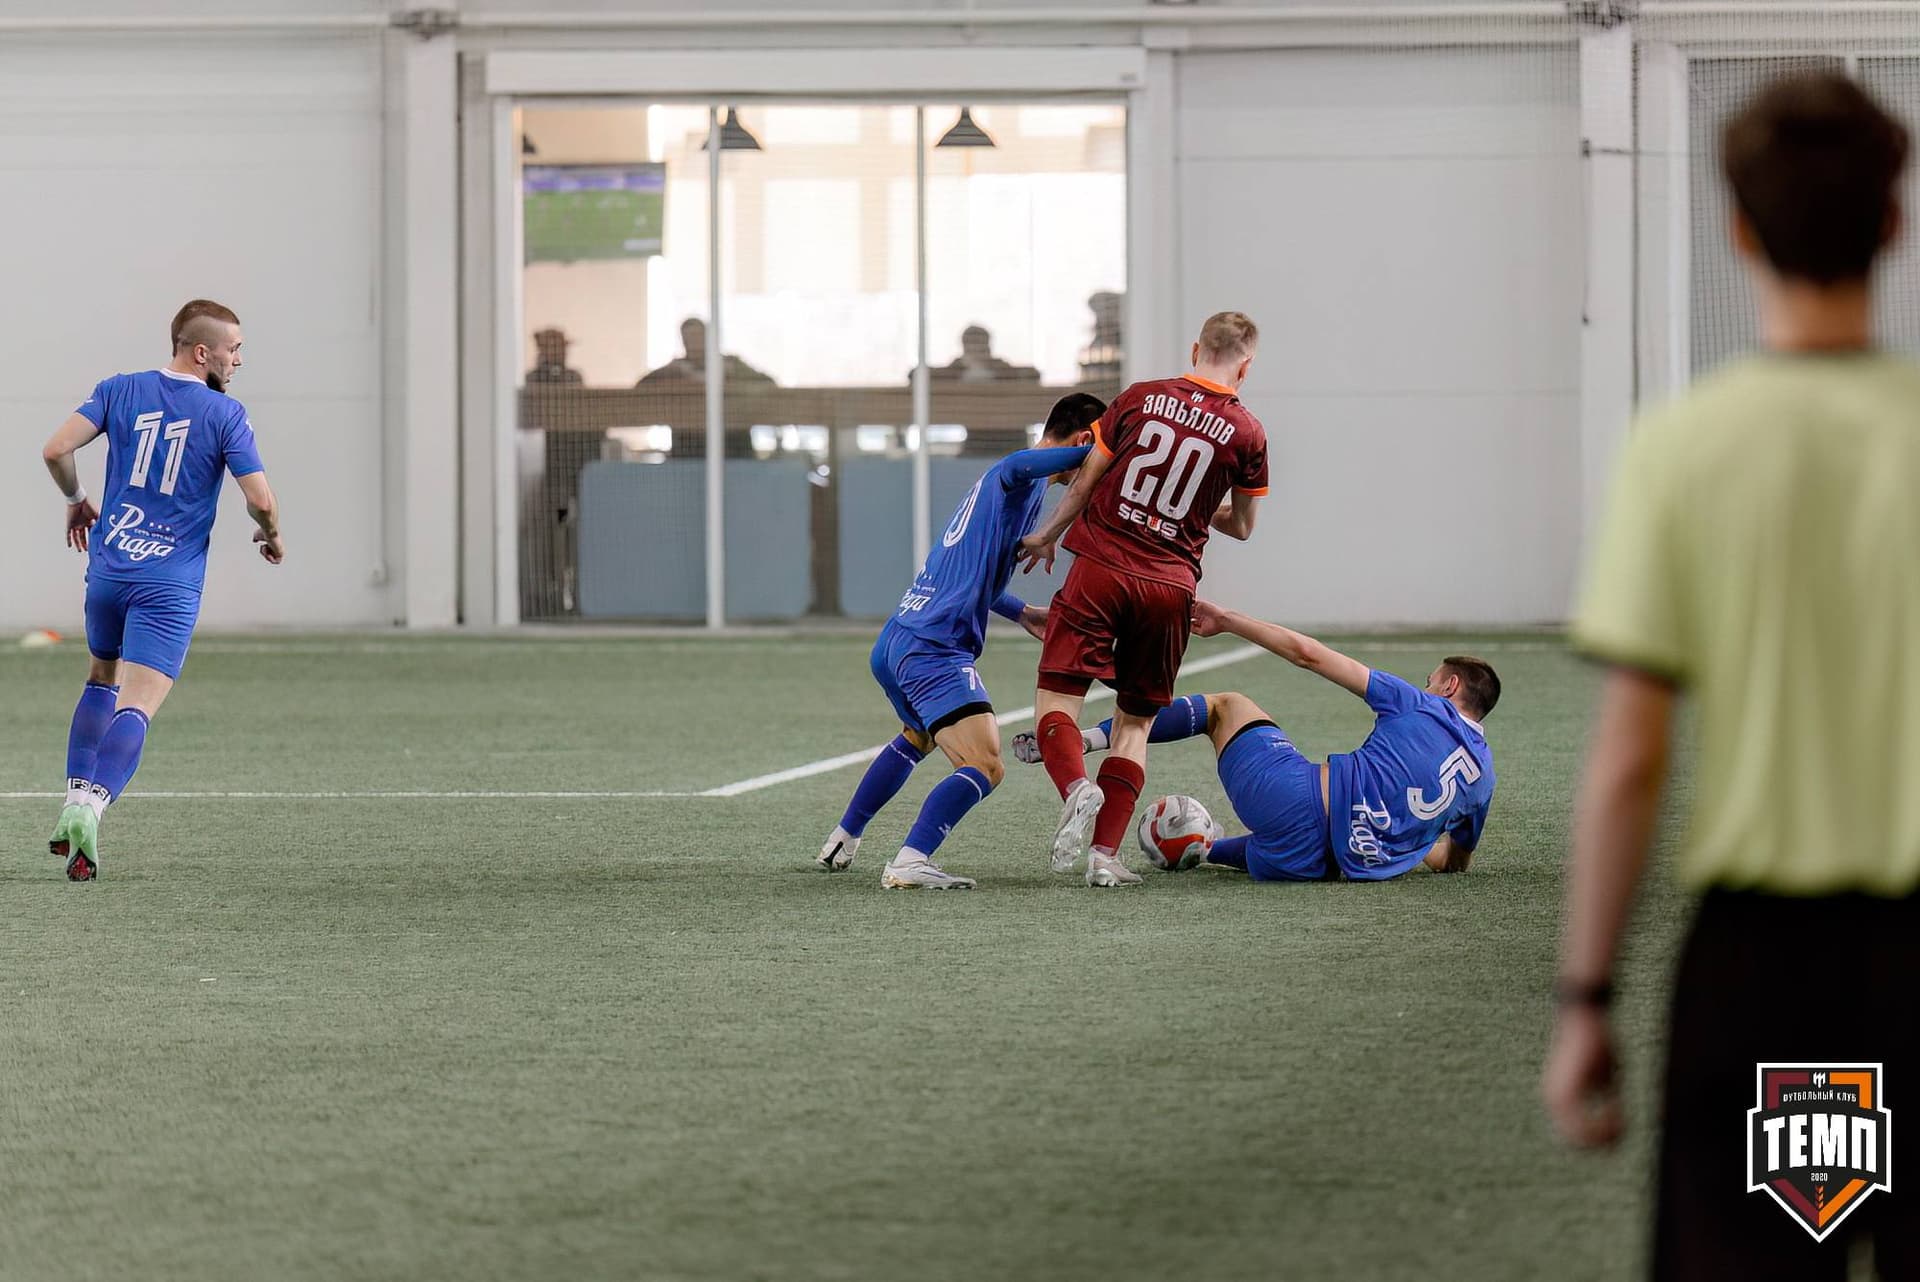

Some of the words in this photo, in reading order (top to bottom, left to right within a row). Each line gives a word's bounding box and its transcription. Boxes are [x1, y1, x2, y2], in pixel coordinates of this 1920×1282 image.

[1142, 393, 1236, 446] ЗАВЬЯЛОВ
[129, 411, 191, 496] 11
[1119, 419, 1215, 521] 20
[104, 503, 176, 561] Praga
[1117, 503, 1179, 538] SEUS
[961, 667, 986, 691] 7
[1407, 746, 1481, 821] 5
